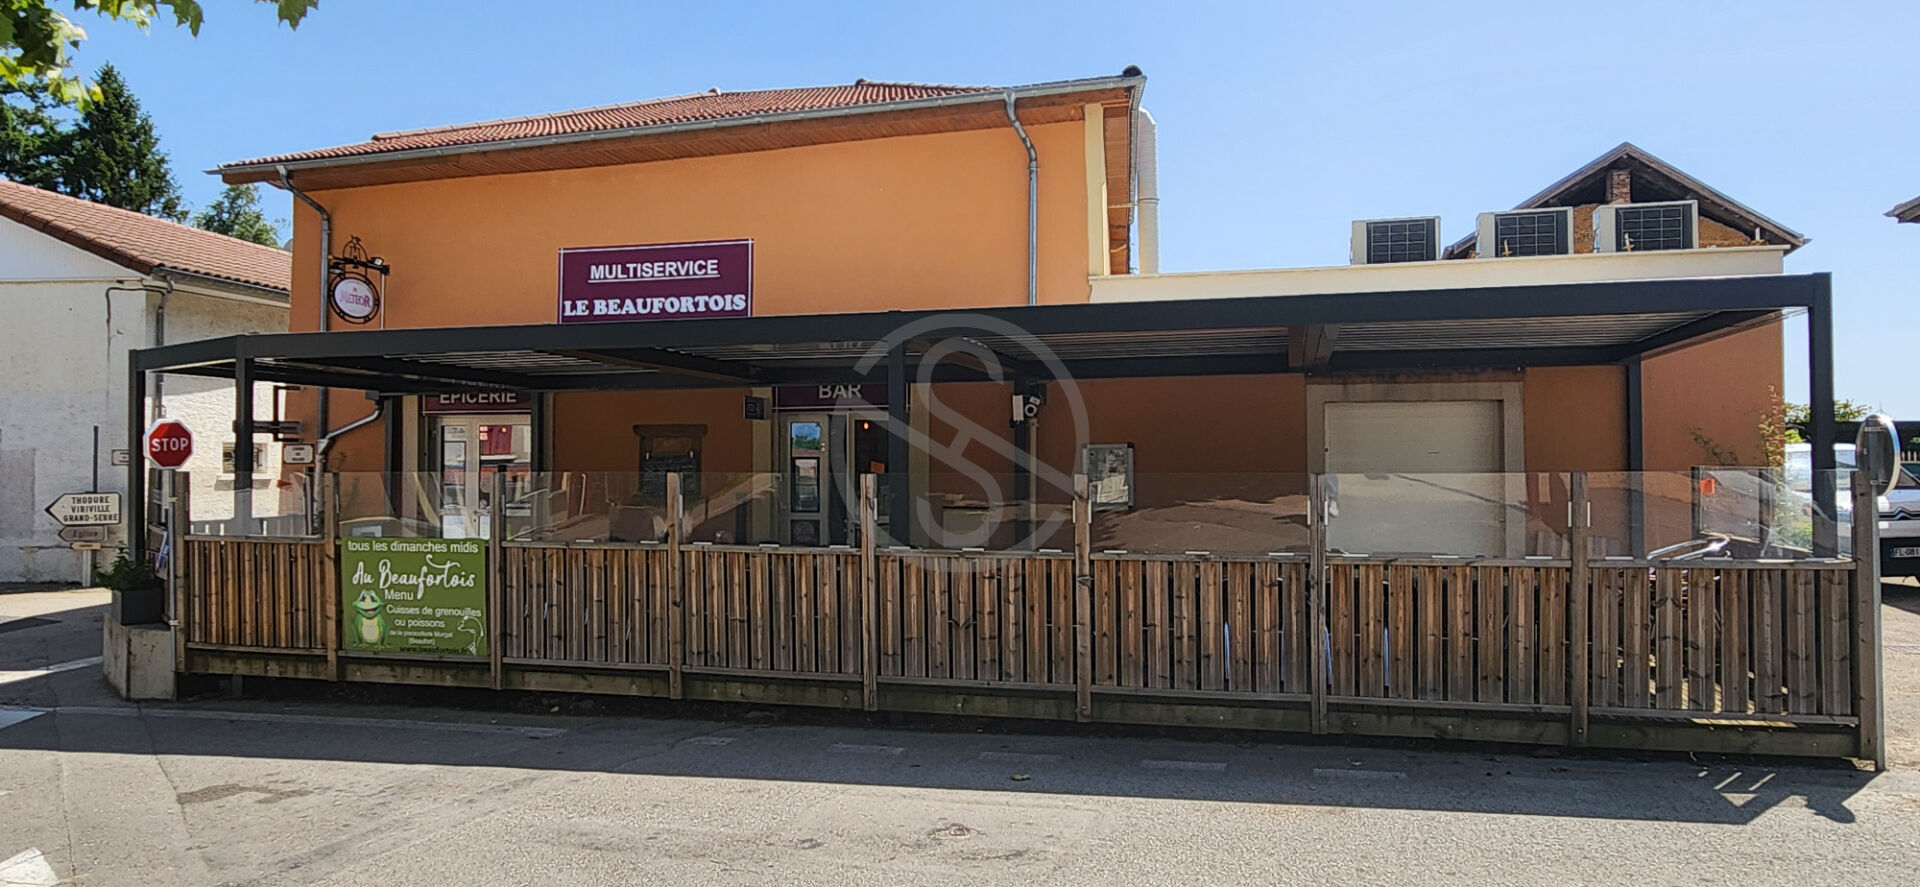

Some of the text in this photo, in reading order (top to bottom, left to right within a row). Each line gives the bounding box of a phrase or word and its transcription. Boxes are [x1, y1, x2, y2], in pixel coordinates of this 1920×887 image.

[590, 259, 719, 280] MULTISERVICE
[563, 294, 747, 316] LE BEAUFORTOIS
[818, 383, 862, 399] BAR
[151, 437, 189, 452] STOP
[72, 495, 110, 504] THODURE
[71, 505, 110, 513] VIRIVILLE
[63, 513, 118, 522] GRAND-SERRE
[348, 540, 479, 553] tous les dimanches midis
[352, 553, 476, 599] Au Beaufortois
[384, 588, 414, 600] Menu
[386, 604, 482, 618] Cuisses de grenouilles
[394, 618, 446, 628] ou poissons
